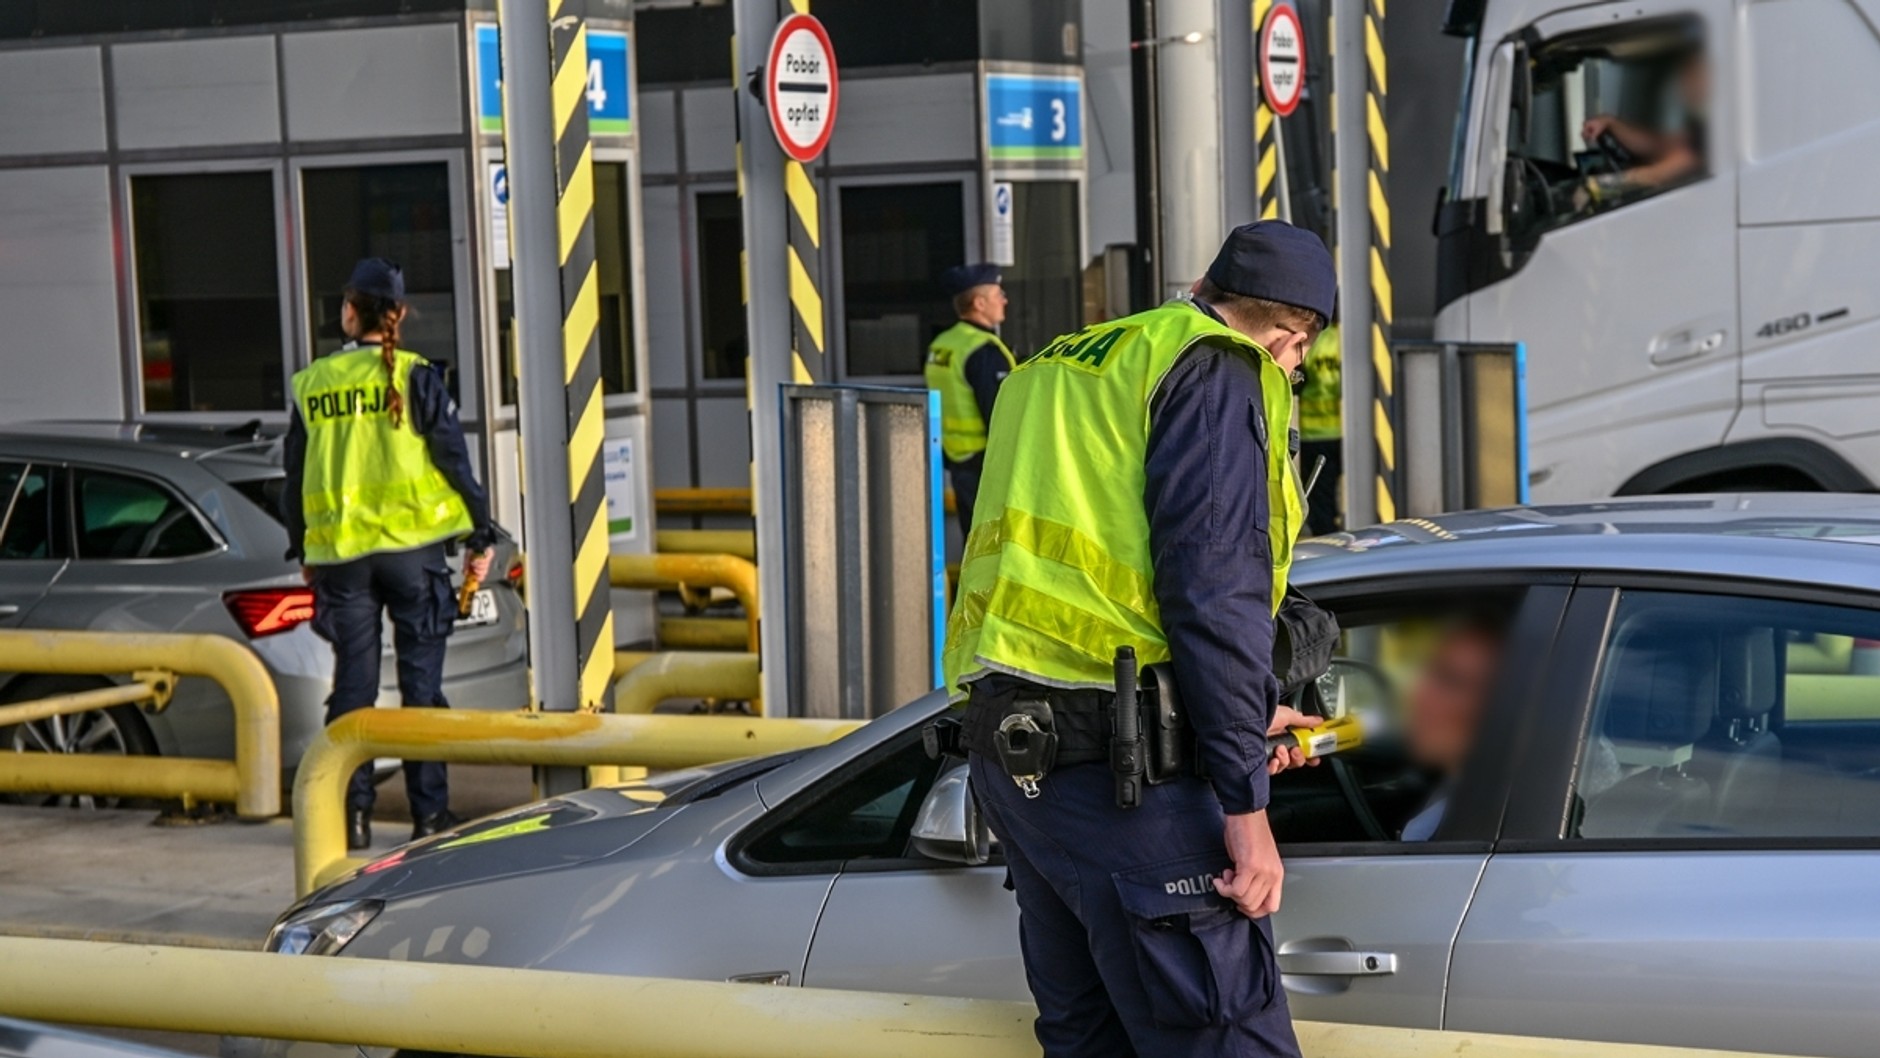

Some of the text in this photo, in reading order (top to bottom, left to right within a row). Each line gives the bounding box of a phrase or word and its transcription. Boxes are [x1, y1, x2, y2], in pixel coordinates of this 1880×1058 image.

[786, 53, 820, 74] Pobór
[585, 59, 607, 112] 4
[787, 101, 820, 126] opłat
[1051, 98, 1066, 141] 3
[1756, 312, 1811, 338] 460
[1164, 873, 1216, 895] POLIC
